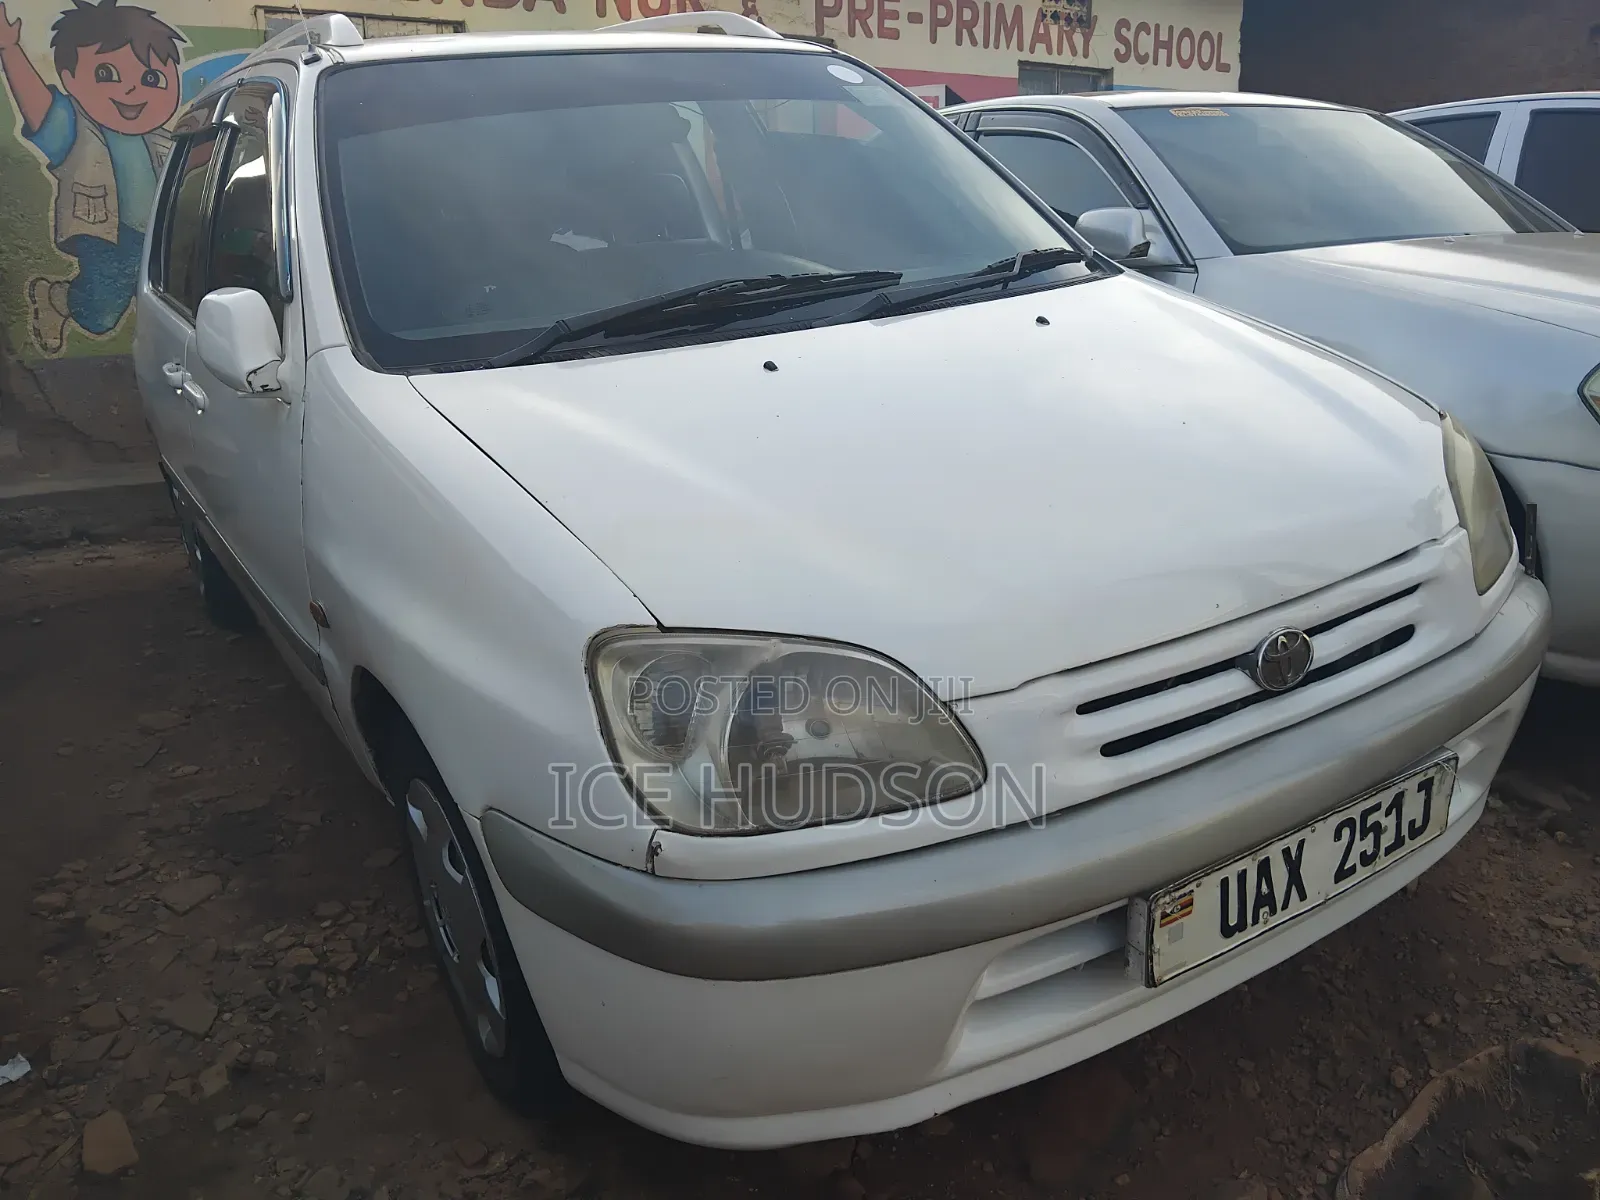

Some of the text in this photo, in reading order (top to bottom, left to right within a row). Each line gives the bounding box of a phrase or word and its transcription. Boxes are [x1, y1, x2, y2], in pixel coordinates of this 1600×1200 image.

[1114, 18, 1231, 73] SCHOOL
[1219, 776, 1434, 939] UAX 251J
